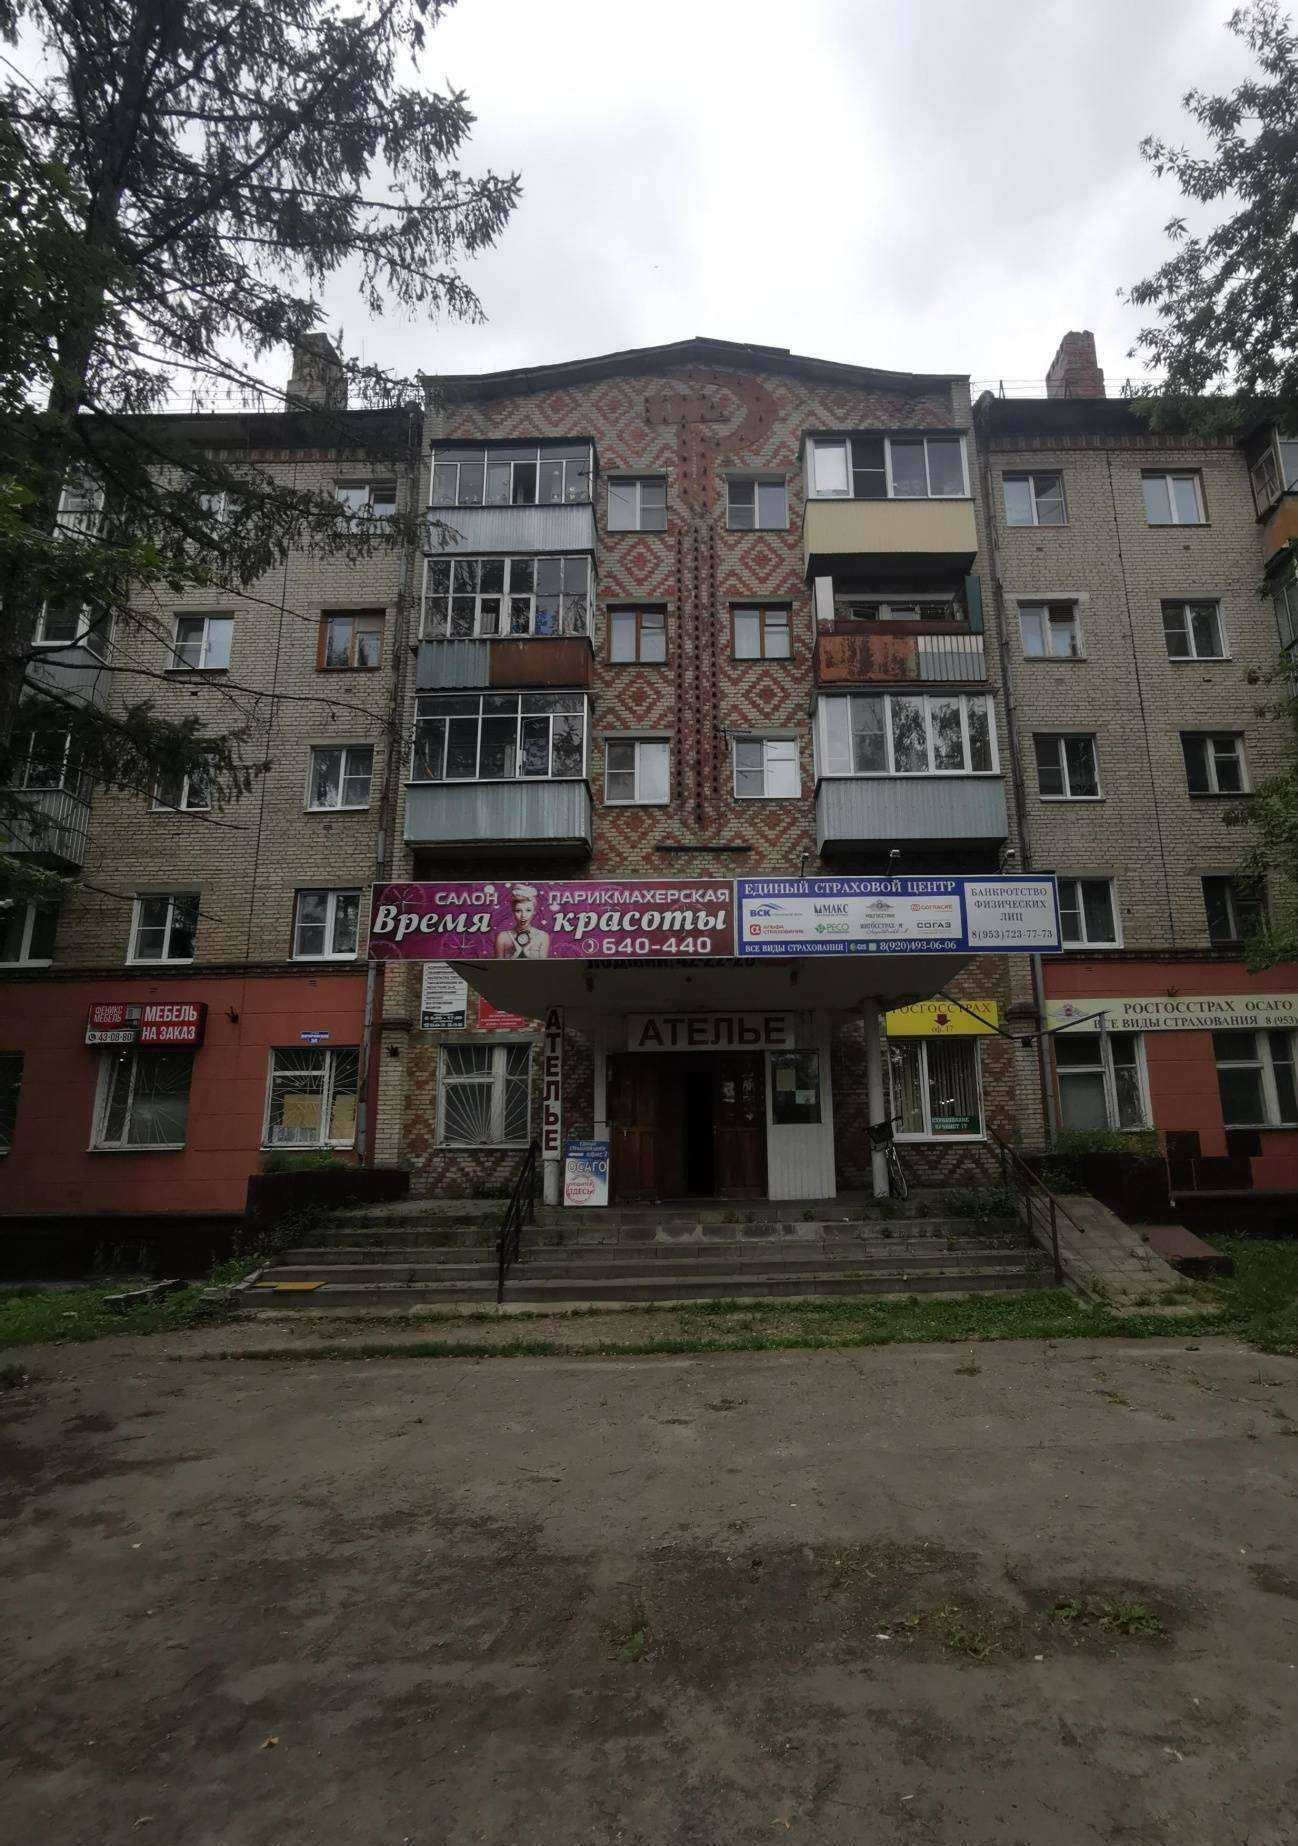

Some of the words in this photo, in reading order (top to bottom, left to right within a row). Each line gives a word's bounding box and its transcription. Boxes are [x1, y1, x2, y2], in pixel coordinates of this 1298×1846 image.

[744, 880, 809, 896] ЕДИНЫЙ
[814, 879, 901, 894] СТРАХОВОЙ
[907, 880, 956, 895] ЦЕНТР
[971, 887, 1048, 897] БАНКРОТСТВО
[435, 891, 499, 906] САЛОН
[548, 888, 731, 905] ПАРИКМАХЕРСКАЯ
[974, 899, 1047, 910] ФИЗИЧЕСКИХ
[749, 909, 771, 918] ВСК
[1000, 912, 1024, 922] ЛИЦ
[372, 903, 492, 941] Время
[553, 908, 727, 940] красоты
[826, 923, 850, 932] РЕСО
[917, 921, 952, 930] СОГАЗ
[602, 936, 713, 954] 640-440
[745, 944, 761, 953] ВСЕ
[762, 944, 786, 953] ВИДЫ
[788, 943, 845, 953] СТРАХОВАНИЯ
[880, 940, 957, 952] 8(920)493-06-06
[144, 1005, 198, 1022] МЕБЕЛЬ
[1122, 1000, 1236, 1015] РОСГОССТРАХ
[1245, 1000, 1293, 1012] ОСАГО
[93, 1014, 122, 1023] МЕБЕЛЬ
[1093, 1017, 1121, 1030] ВЕ
[1122, 1017, 1161, 1030] ВИДЫ
[1163, 1015, 1259, 1028] СТРАХОВАНИЯ
[142, 1026, 157, 1040] НА
[159, 1026, 196, 1040] ЗАКАЗ
[638, 1016, 787, 1047] АТЕЛЬЕ
[543, 1009, 563, 1151] АТЕЛЬЕ
